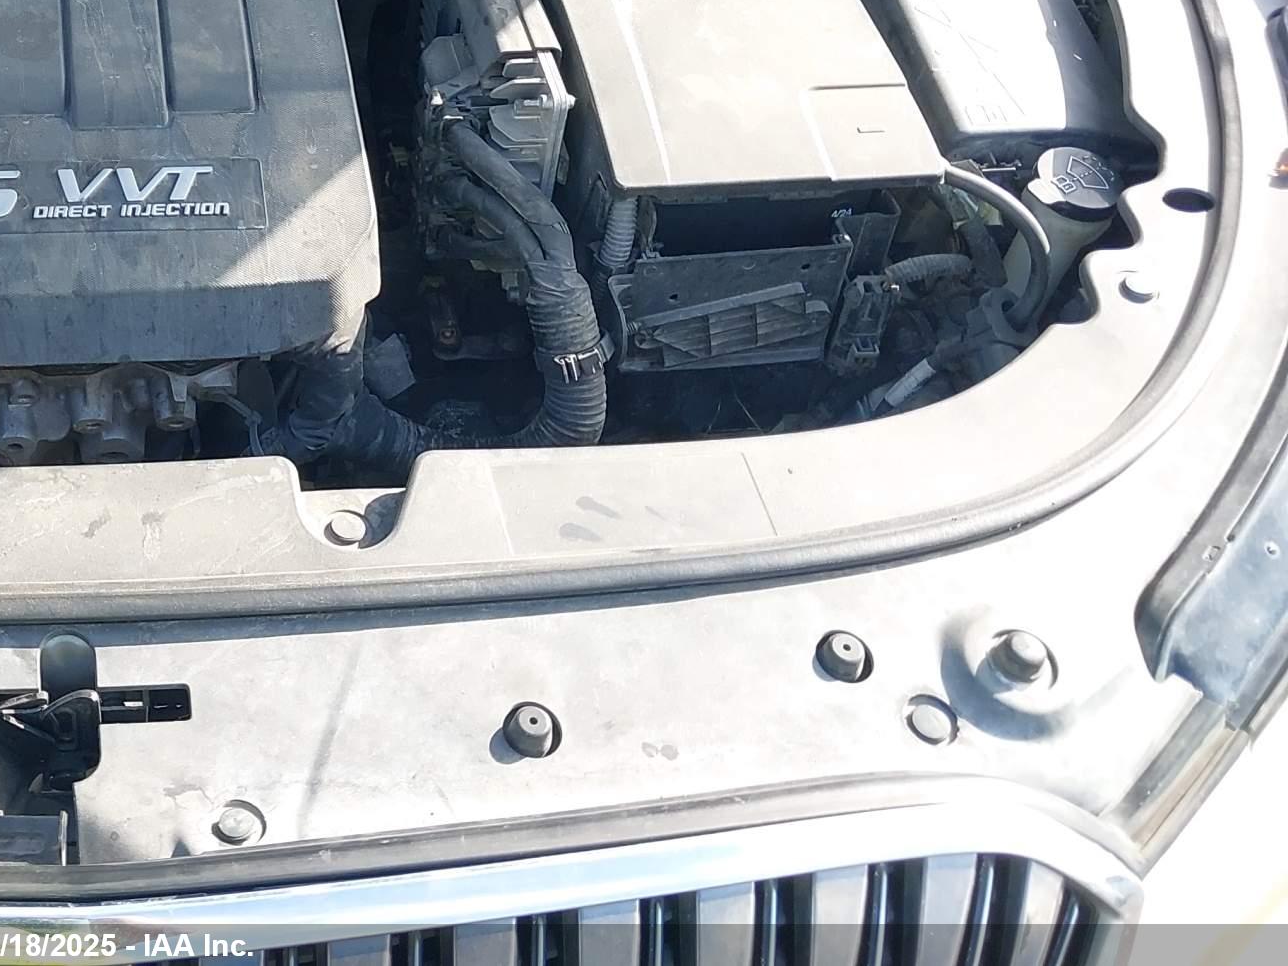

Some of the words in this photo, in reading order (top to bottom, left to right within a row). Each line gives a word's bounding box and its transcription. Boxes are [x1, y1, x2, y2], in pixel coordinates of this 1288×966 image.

[57, 166, 214, 203] VVT
[33, 204, 111, 220] DIRECT
[120, 201, 231, 217] INJECTION
